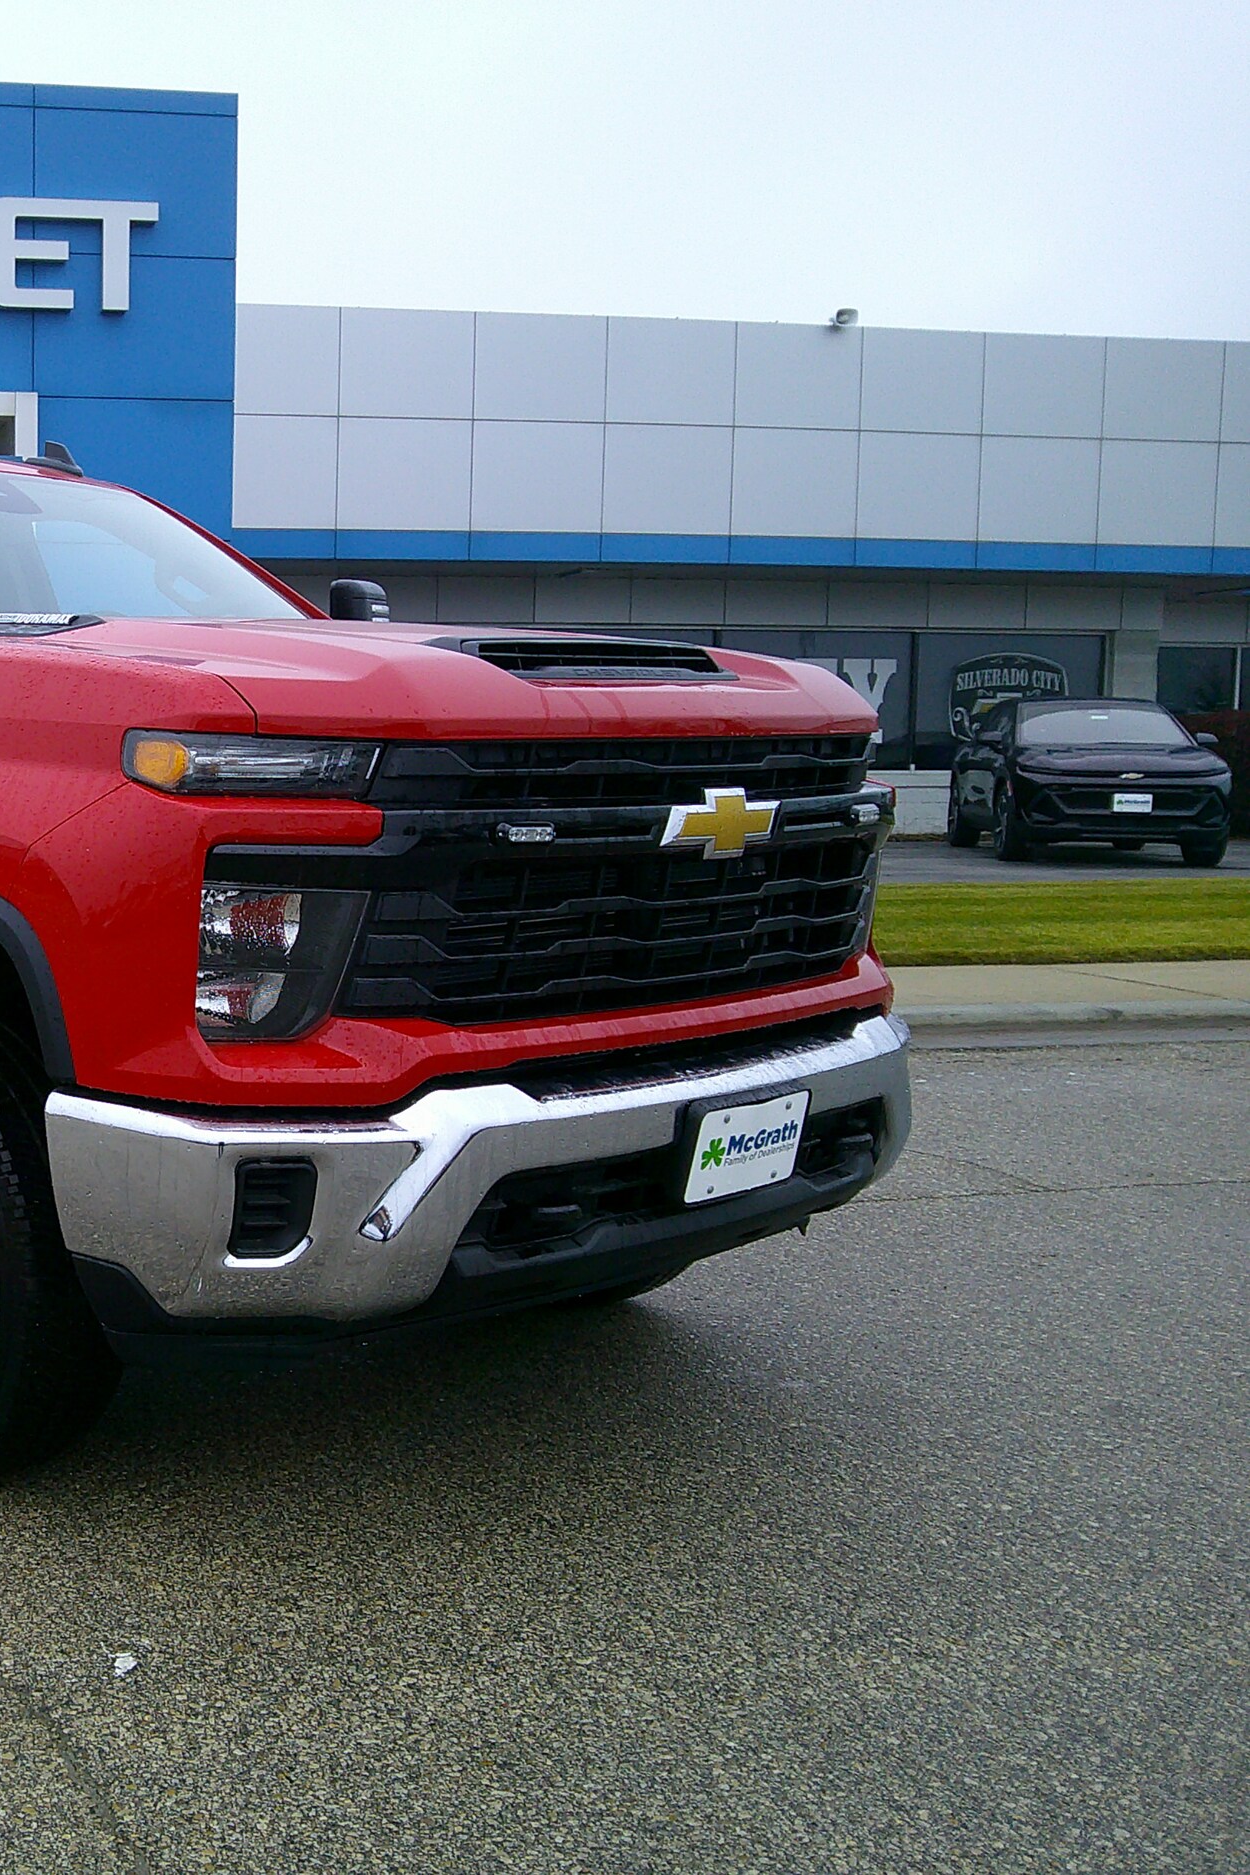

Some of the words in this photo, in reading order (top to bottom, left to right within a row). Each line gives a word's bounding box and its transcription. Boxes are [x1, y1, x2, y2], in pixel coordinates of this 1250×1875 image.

[573, 668, 682, 678] CHEVROLET
[956, 668, 1029, 692] SILVERADO
[1032, 670, 1062, 692] CITY
[726, 1119, 799, 1156] McGrath
[724, 1154, 748, 1167] Family
[749, 1150, 758, 1161] of
[757, 1141, 795, 1159] Dealerships
